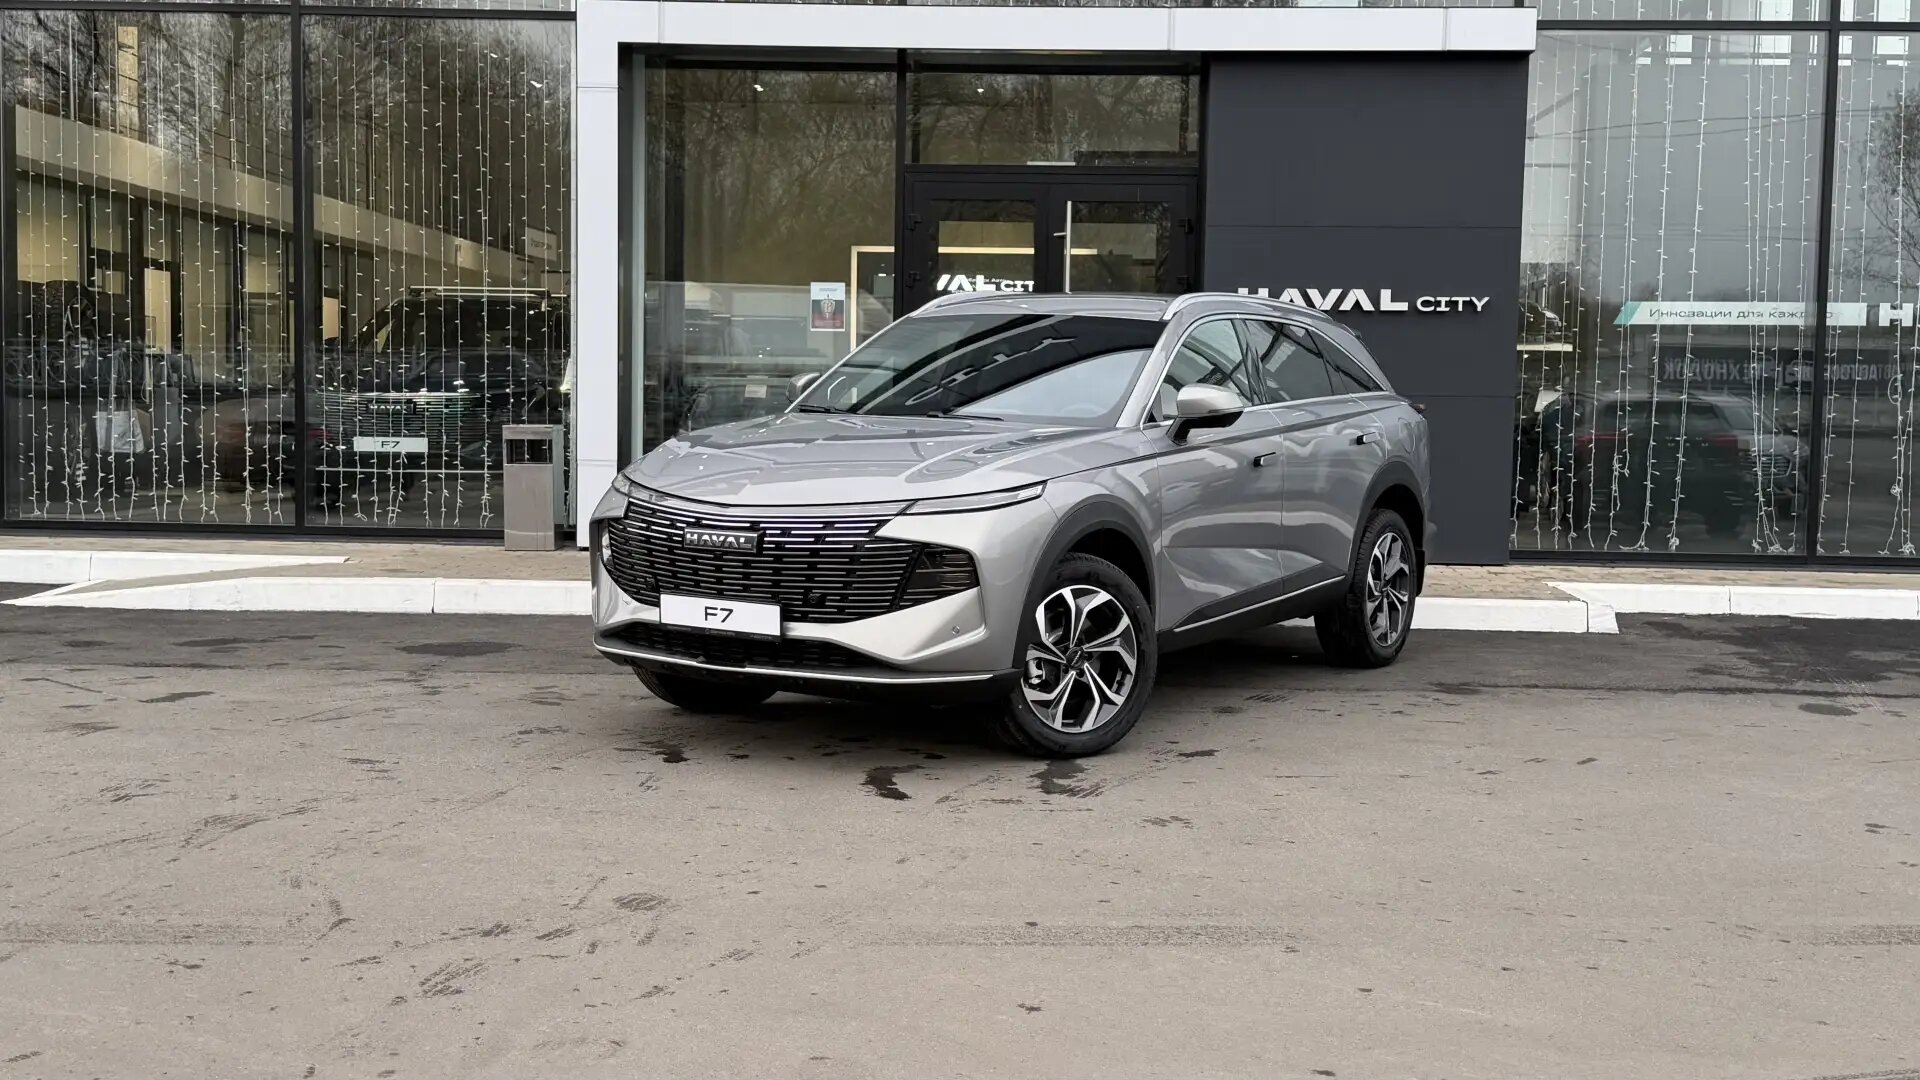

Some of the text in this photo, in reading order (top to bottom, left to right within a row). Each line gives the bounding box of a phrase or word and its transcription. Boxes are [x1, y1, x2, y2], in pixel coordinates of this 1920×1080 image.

[1416, 296, 1490, 312] CITY
[1649, 308, 1732, 319] Инновации
[1737, 310, 1764, 320] для
[381, 441, 400, 449] F7
[686, 533, 752, 549] HAVAL
[704, 605, 734, 623] F7
